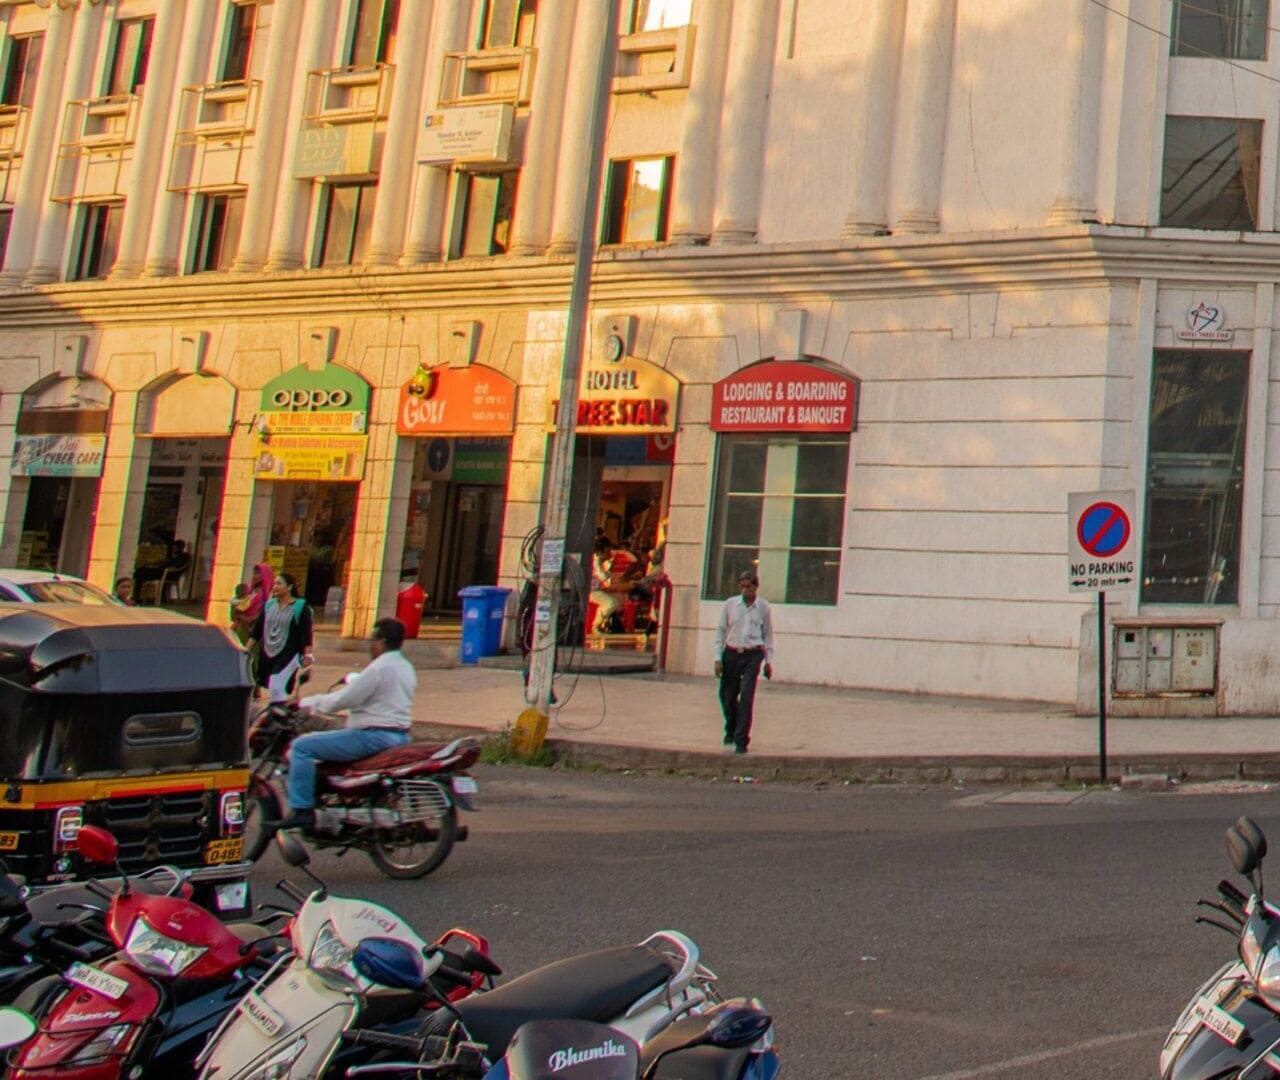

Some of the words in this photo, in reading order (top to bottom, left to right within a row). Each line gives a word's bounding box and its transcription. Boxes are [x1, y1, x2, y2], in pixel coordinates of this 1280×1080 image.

[585, 370, 638, 390] HOTEL
[723, 380, 773, 402] LODGING
[775, 381, 783, 401] &
[787, 380, 847, 401] BOARDING
[552, 400, 616, 426] TREE
[617, 399, 668, 426] STAR
[721, 406, 785, 425] RESTAURANT
[787, 406, 795, 424] &
[797, 405, 847, 426] BANQUET
[43, 452, 73, 465] CYBER
[77, 452, 101, 465] CAFE
[1071, 563, 1085, 576] NO
[1088, 561, 1134, 575] PARKING
[1087, 578, 1098, 587] 20
[1101, 577, 1117, 587] mtr
[210, 848, 240, 862] 0483
[548, 1039, 627, 1072] Bhumika
